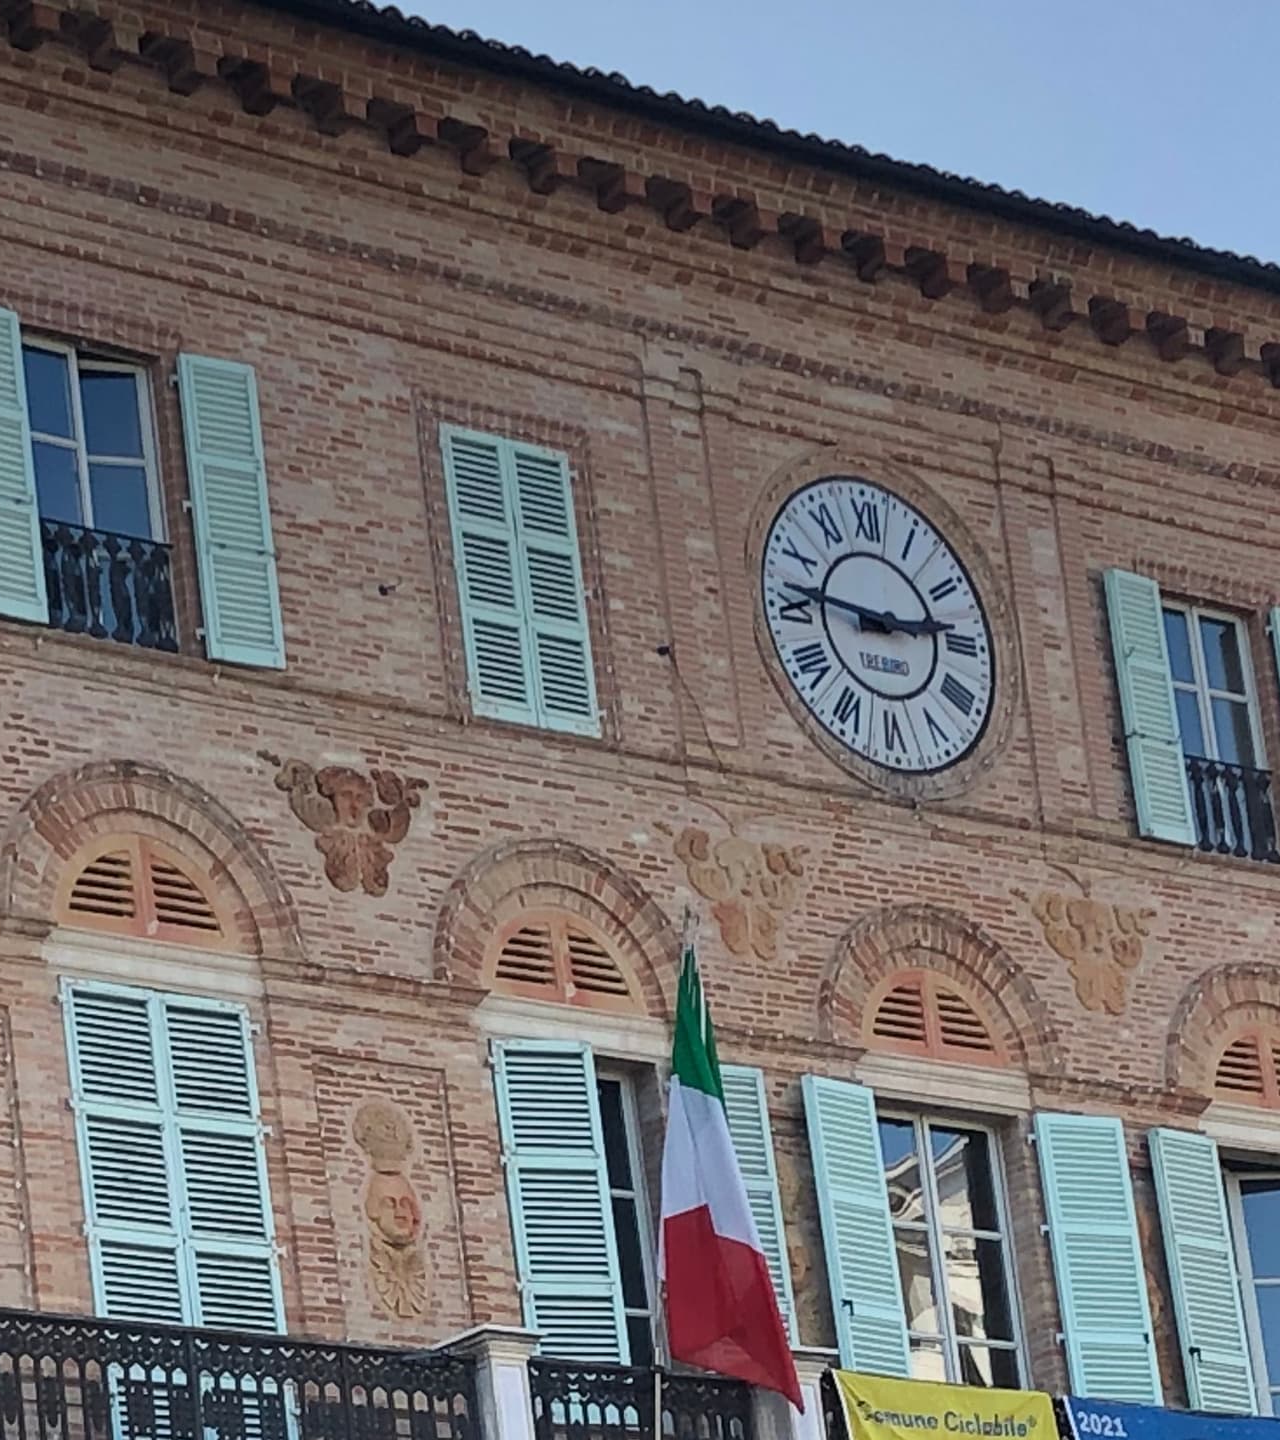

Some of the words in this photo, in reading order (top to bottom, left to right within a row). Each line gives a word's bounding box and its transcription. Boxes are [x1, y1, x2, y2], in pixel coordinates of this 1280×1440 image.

[807, 502, 844, 550] XI
[850, 498, 881, 544] XII
[782, 535, 818, 578] X
[929, 577, 958, 602] II
[792, 641, 832, 691] VIII
[944, 632, 978, 658] III
[832, 685, 861, 736] VII
[883, 709, 908, 755] VI
[922, 706, 950, 748] V
[1077, 1411, 1128, 1438] 2021
